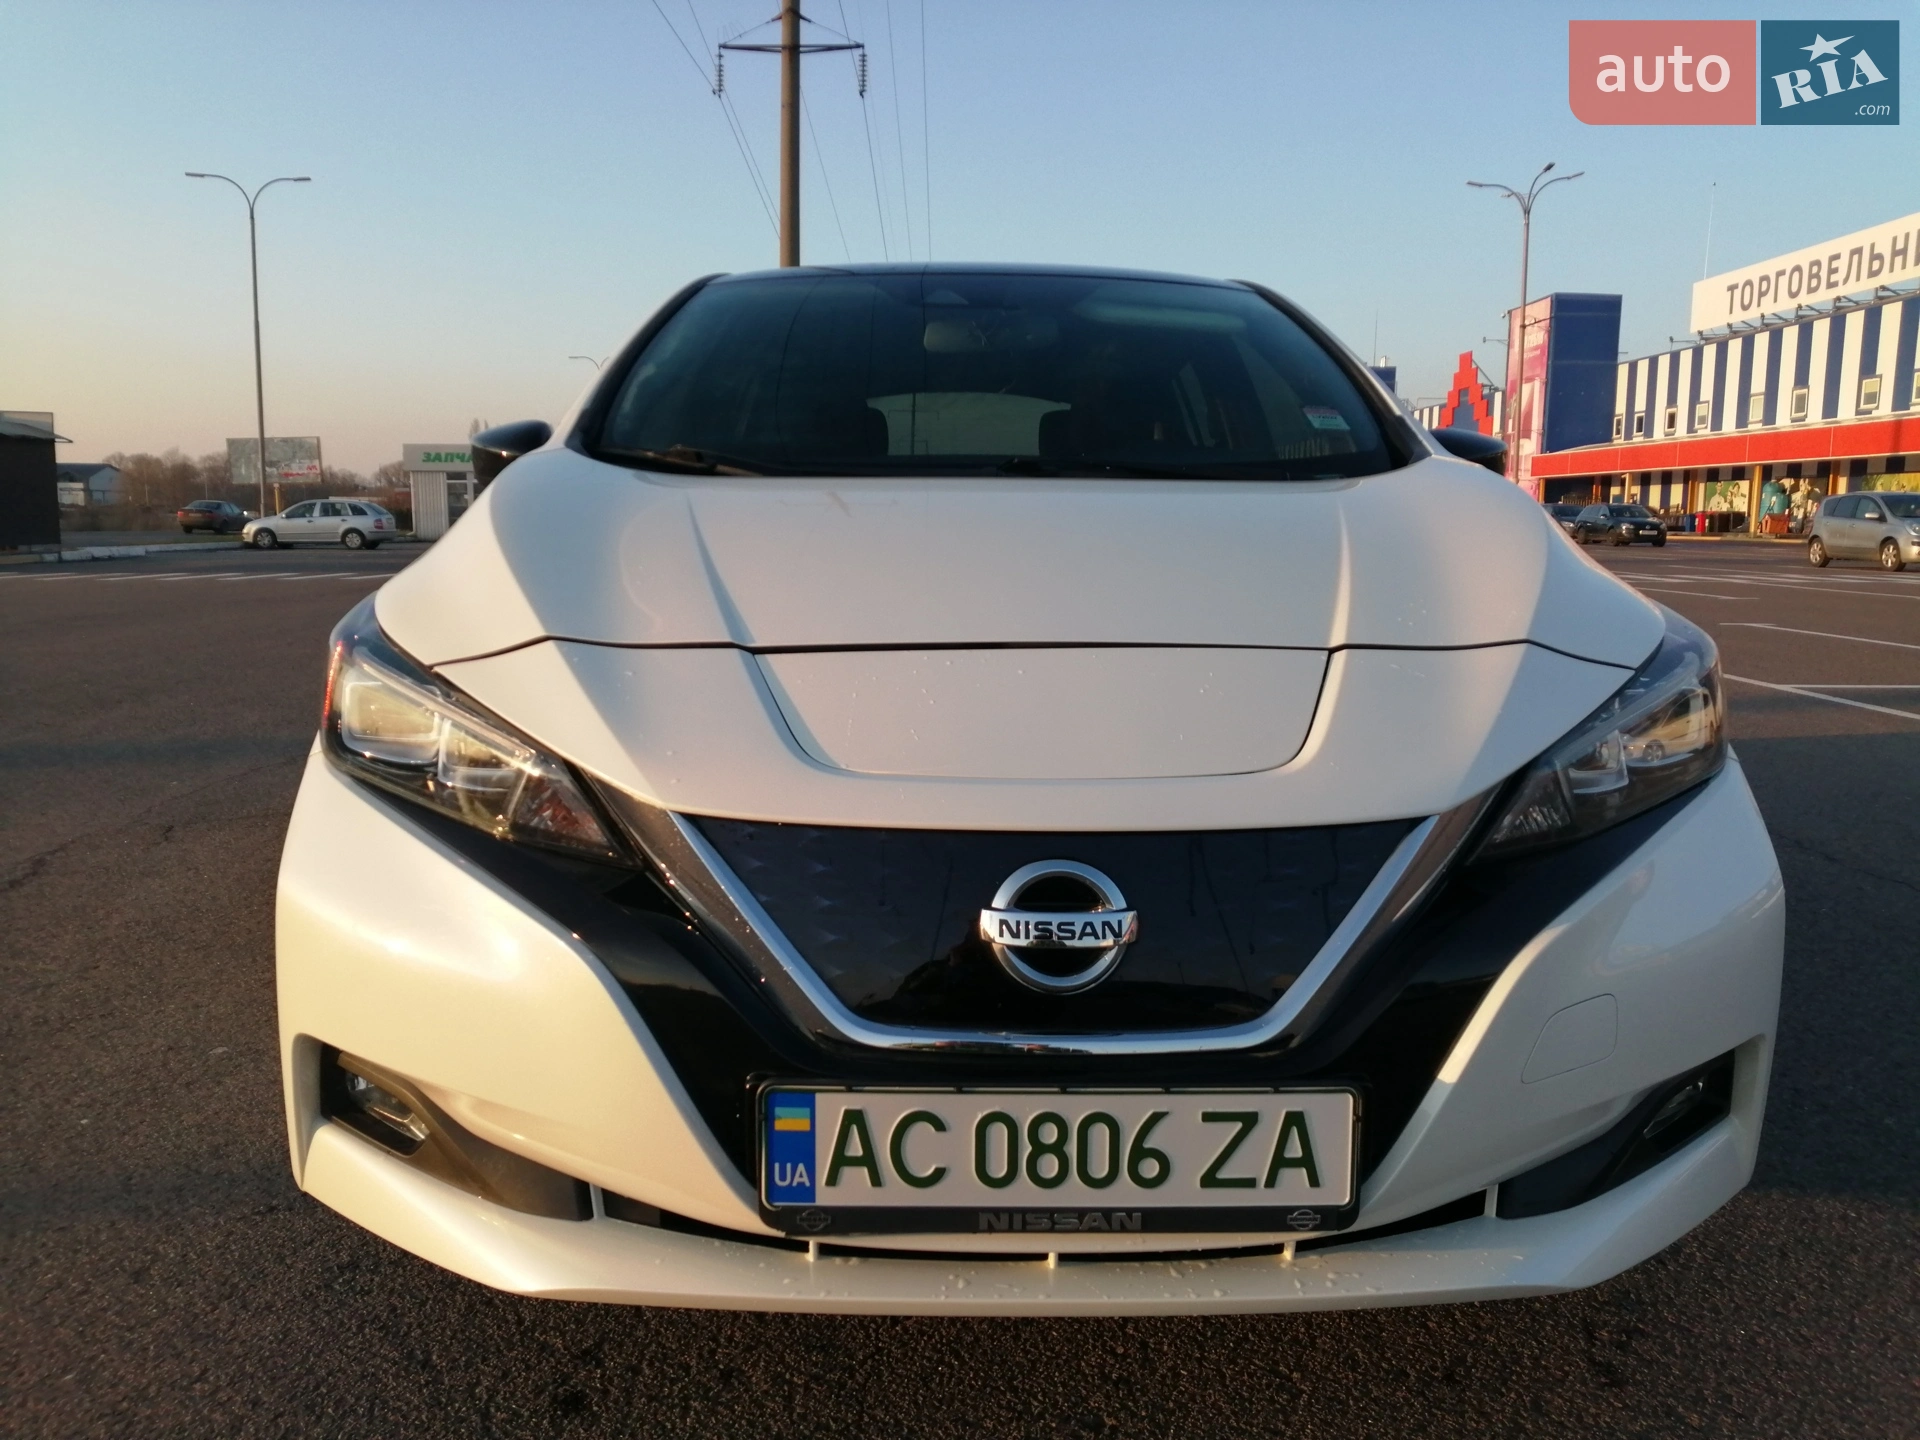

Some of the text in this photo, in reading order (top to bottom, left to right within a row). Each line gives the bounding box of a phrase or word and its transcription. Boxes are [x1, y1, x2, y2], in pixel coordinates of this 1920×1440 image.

[998, 918, 1123, 941] NISSAN
[823, 1108, 1321, 1189] AC 0806 ZA
[774, 1162, 810, 1187] UA
[978, 1212, 1142, 1231] NISSAN
